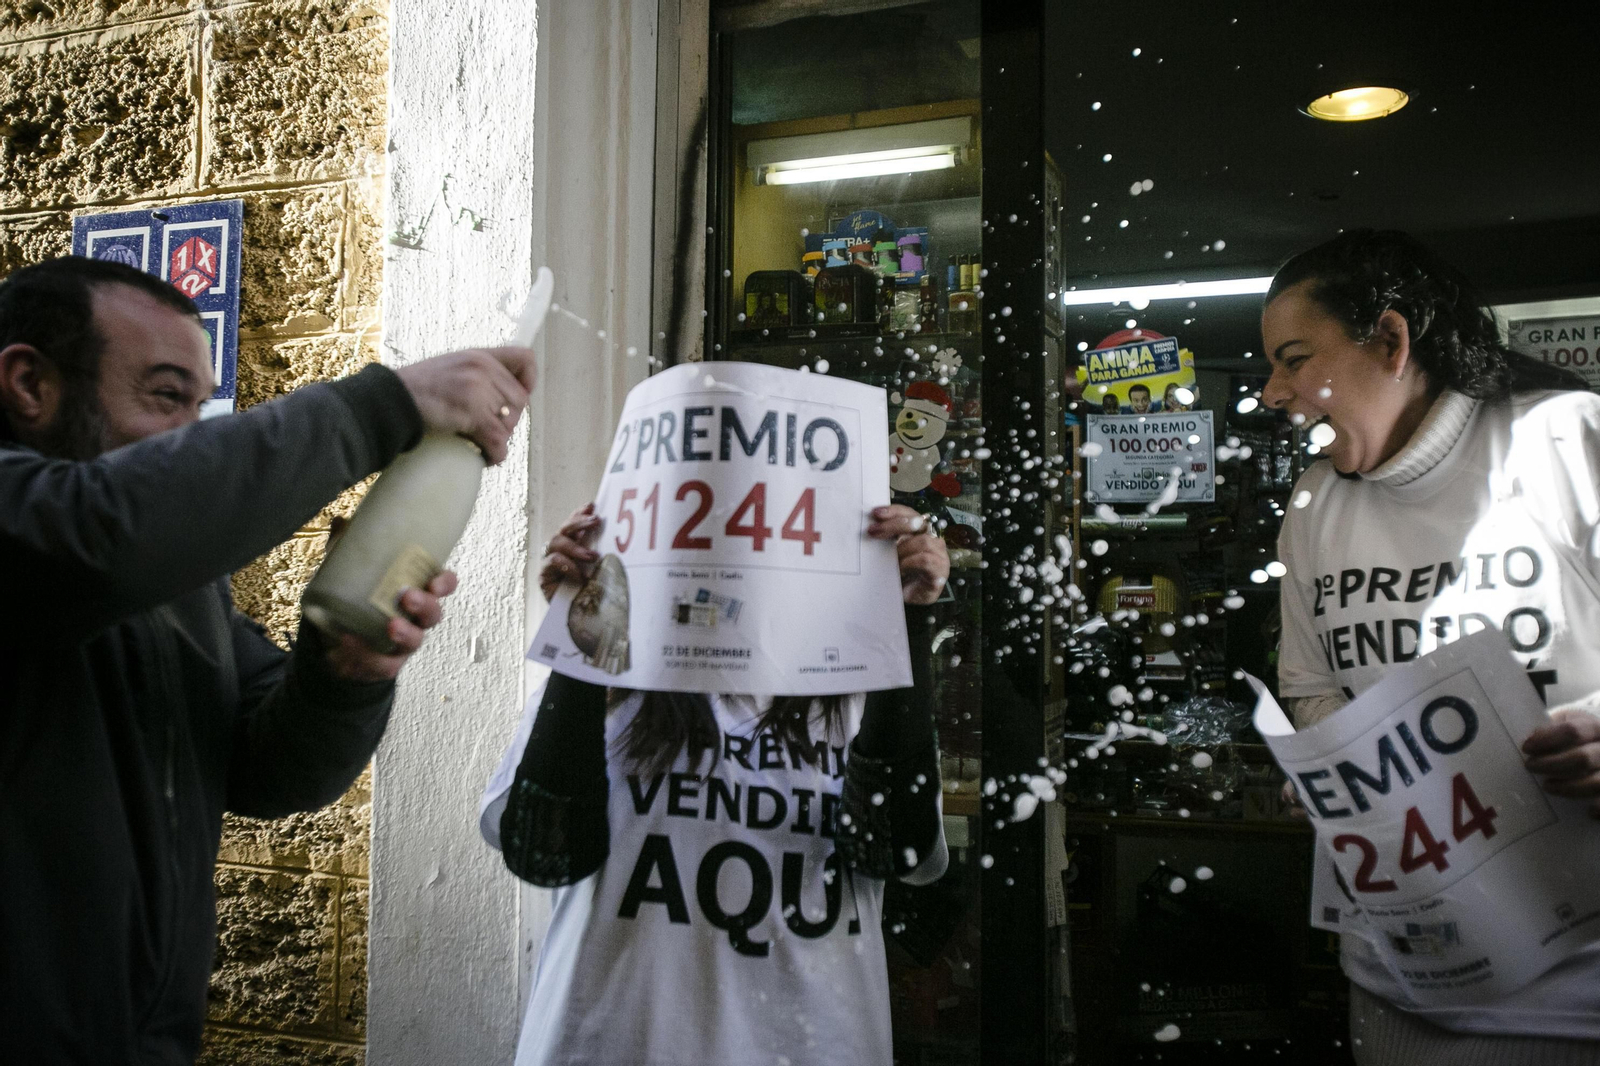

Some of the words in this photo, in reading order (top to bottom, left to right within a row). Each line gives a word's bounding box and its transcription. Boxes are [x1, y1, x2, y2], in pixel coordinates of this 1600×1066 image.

[1528, 327, 1585, 343] GRAN
[1090, 346, 1155, 372] ANIMA
[1540, 347, 1600, 367] 100.
[1091, 370, 1120, 382] PARA
[1121, 363, 1157, 379] GANAR
[1101, 423, 1140, 434] GRAN
[1144, 420, 1197, 434] PREMIO
[1109, 437, 1183, 453] 100.000
[1105, 479, 1160, 491] VENDIDO
[613, 479, 822, 556] 51244
[1120, 594, 1153, 604] Fortuna
[676, 645, 690, 657] DE
[692, 646, 752, 658] DICIEMBRE
[1289, 695, 1480, 820] EMIO
